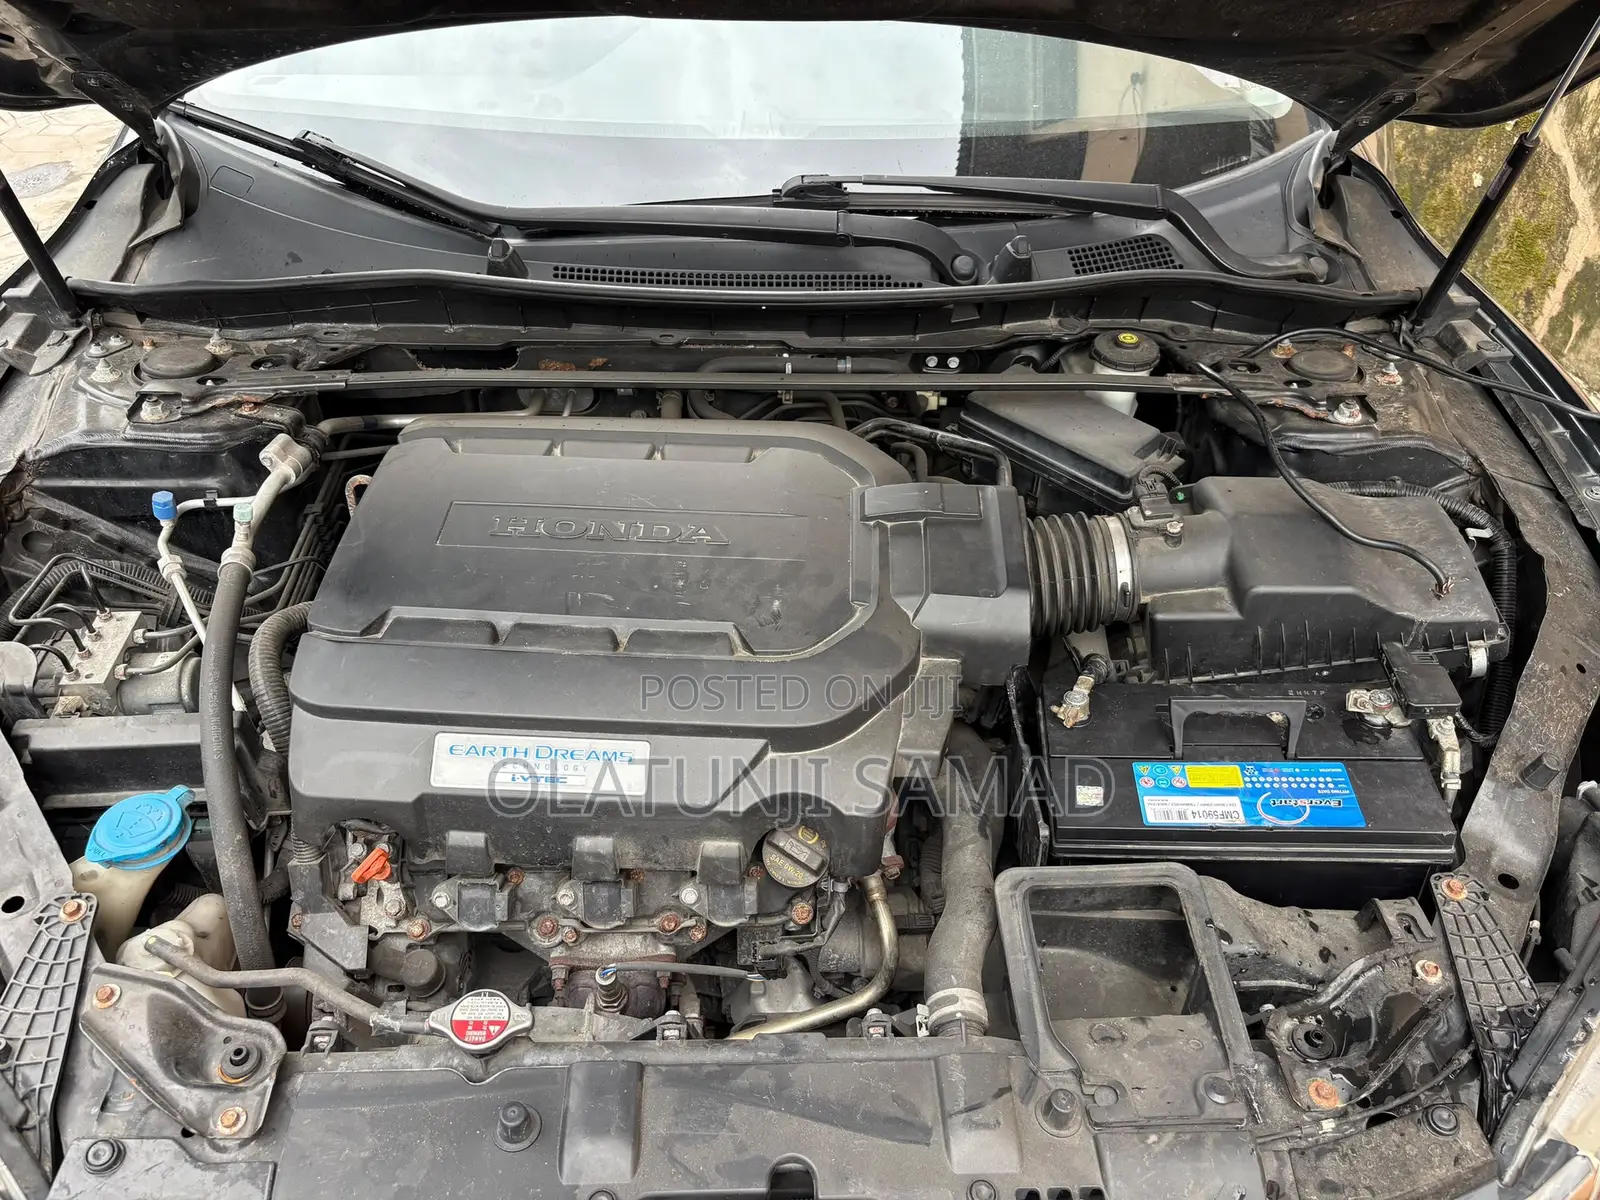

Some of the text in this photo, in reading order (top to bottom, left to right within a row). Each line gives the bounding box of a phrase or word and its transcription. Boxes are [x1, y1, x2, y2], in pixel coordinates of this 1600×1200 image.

[489, 515, 731, 546] HONDA
[448, 743, 635, 763] EARTH DREAMS
[493, 761, 590, 773] TECHNOLOGY
[1270, 798, 1343, 808] Everstart
[1191, 810, 1240, 820] CMF59014
[769, 853, 785, 867] SAE
